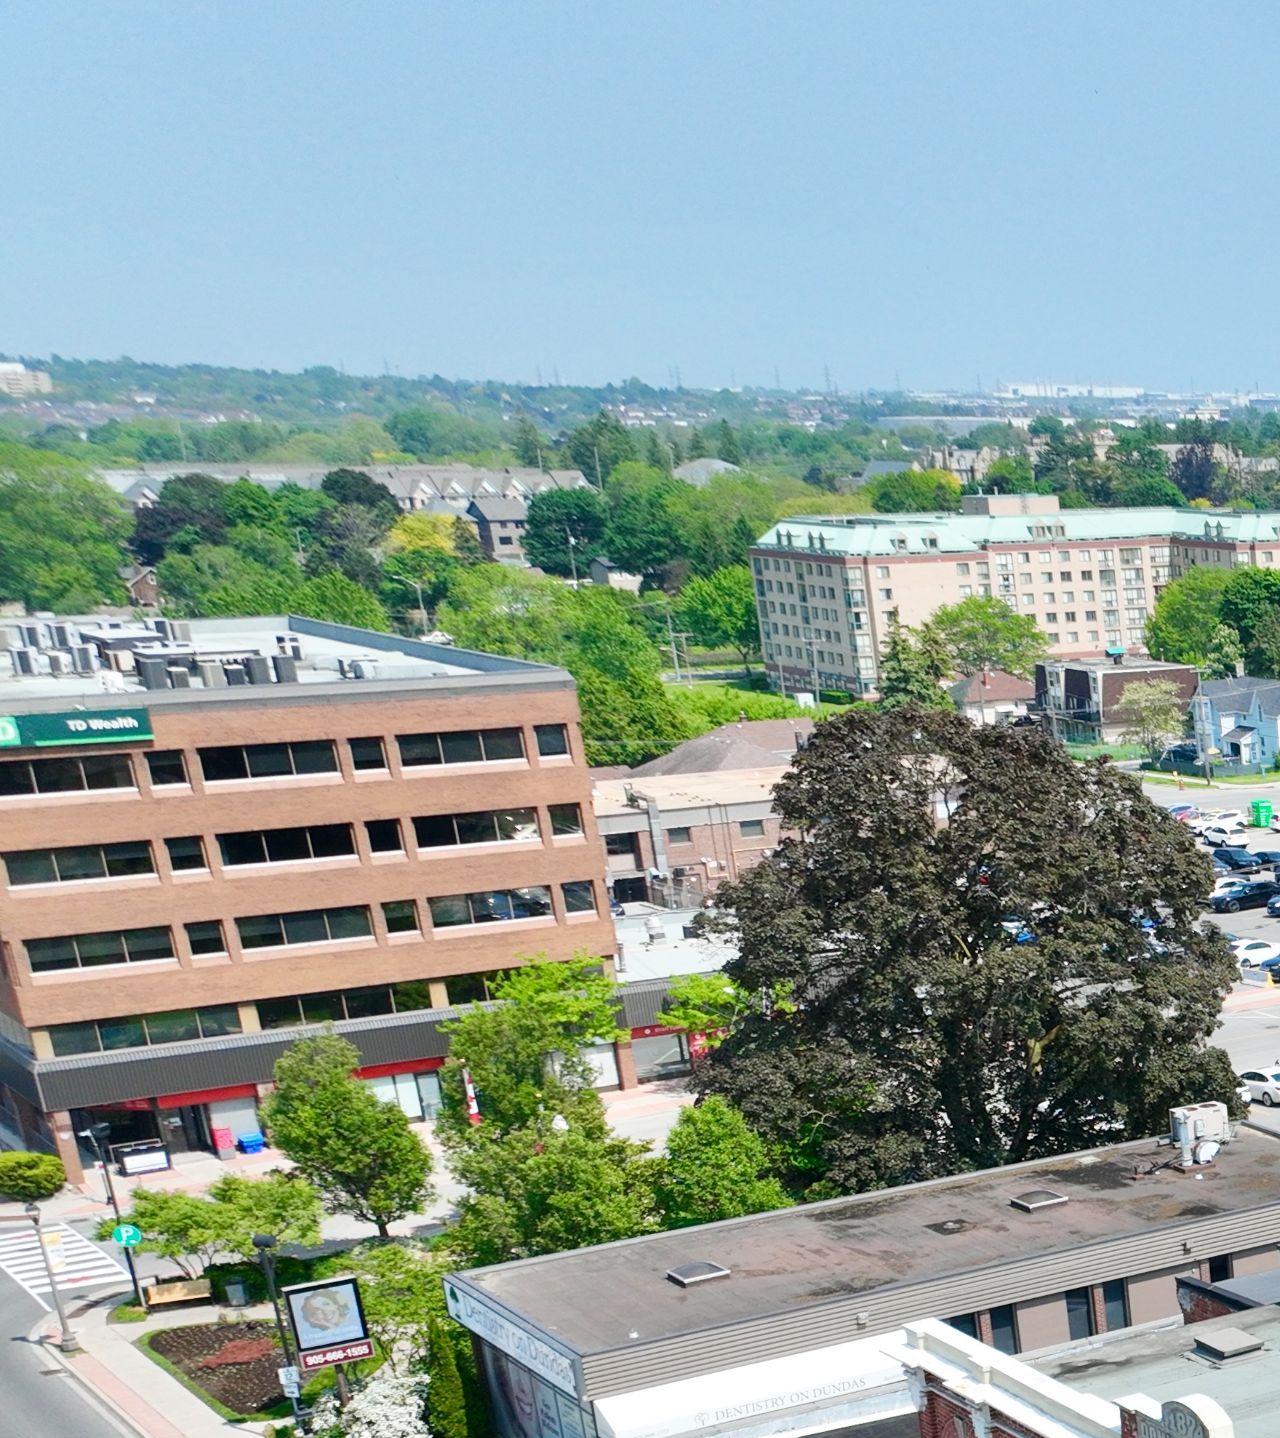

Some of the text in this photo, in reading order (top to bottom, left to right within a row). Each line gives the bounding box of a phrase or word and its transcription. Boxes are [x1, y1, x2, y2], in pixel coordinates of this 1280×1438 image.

[66, 716, 139, 731] TD Wealth
[526, 1335, 572, 1385] Dundas
[715, 1377, 867, 1422] DENTISTRY ON DUNDAS
